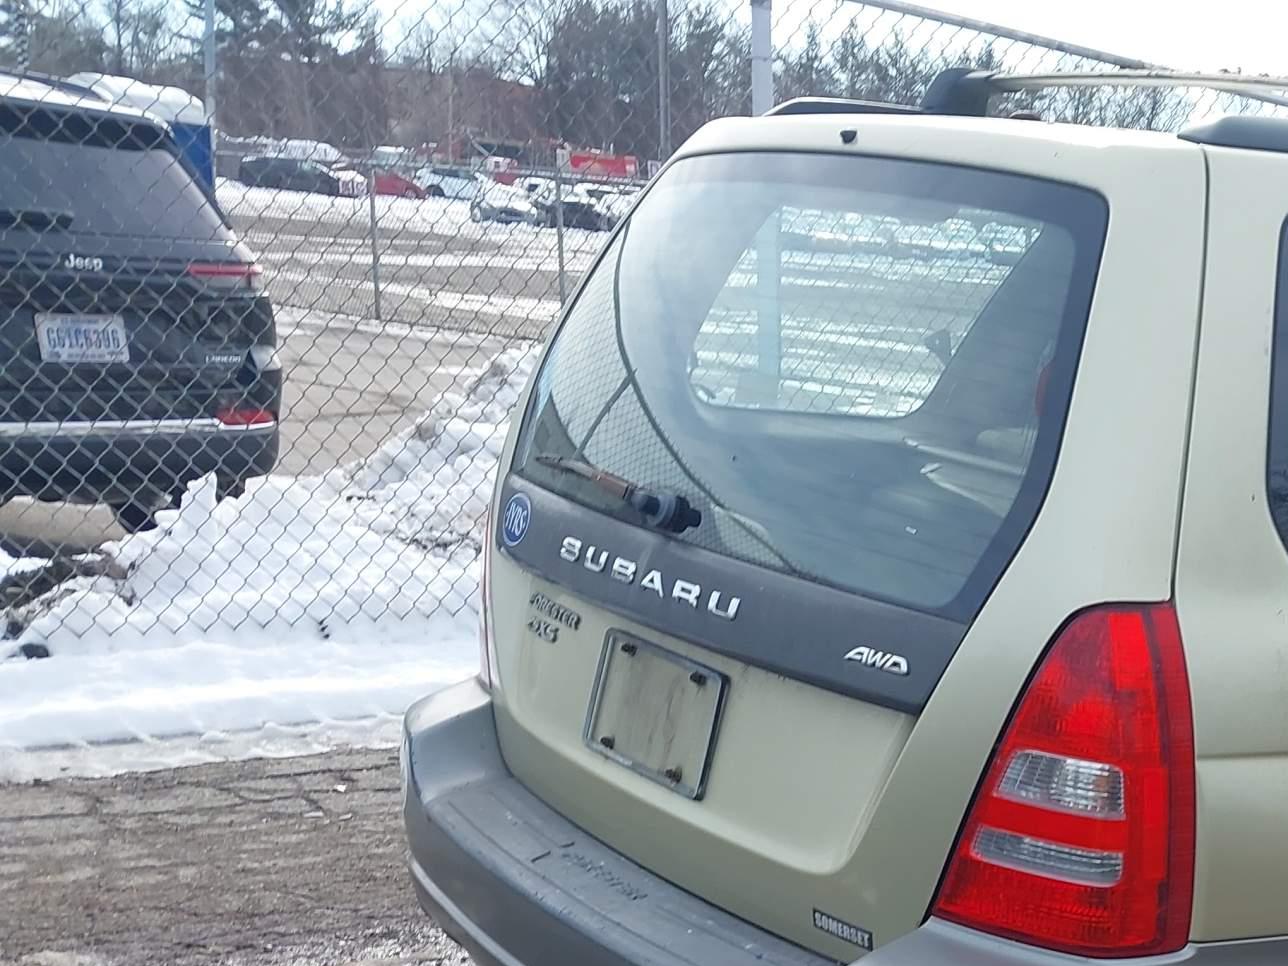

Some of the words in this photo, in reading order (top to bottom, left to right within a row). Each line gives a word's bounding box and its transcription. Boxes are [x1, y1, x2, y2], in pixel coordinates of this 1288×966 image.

[64, 254, 103, 272] Jeep
[560, 536, 741, 621] SUBARU
[844, 646, 910, 676] AWD
[814, 910, 870, 949] SOMERSET
